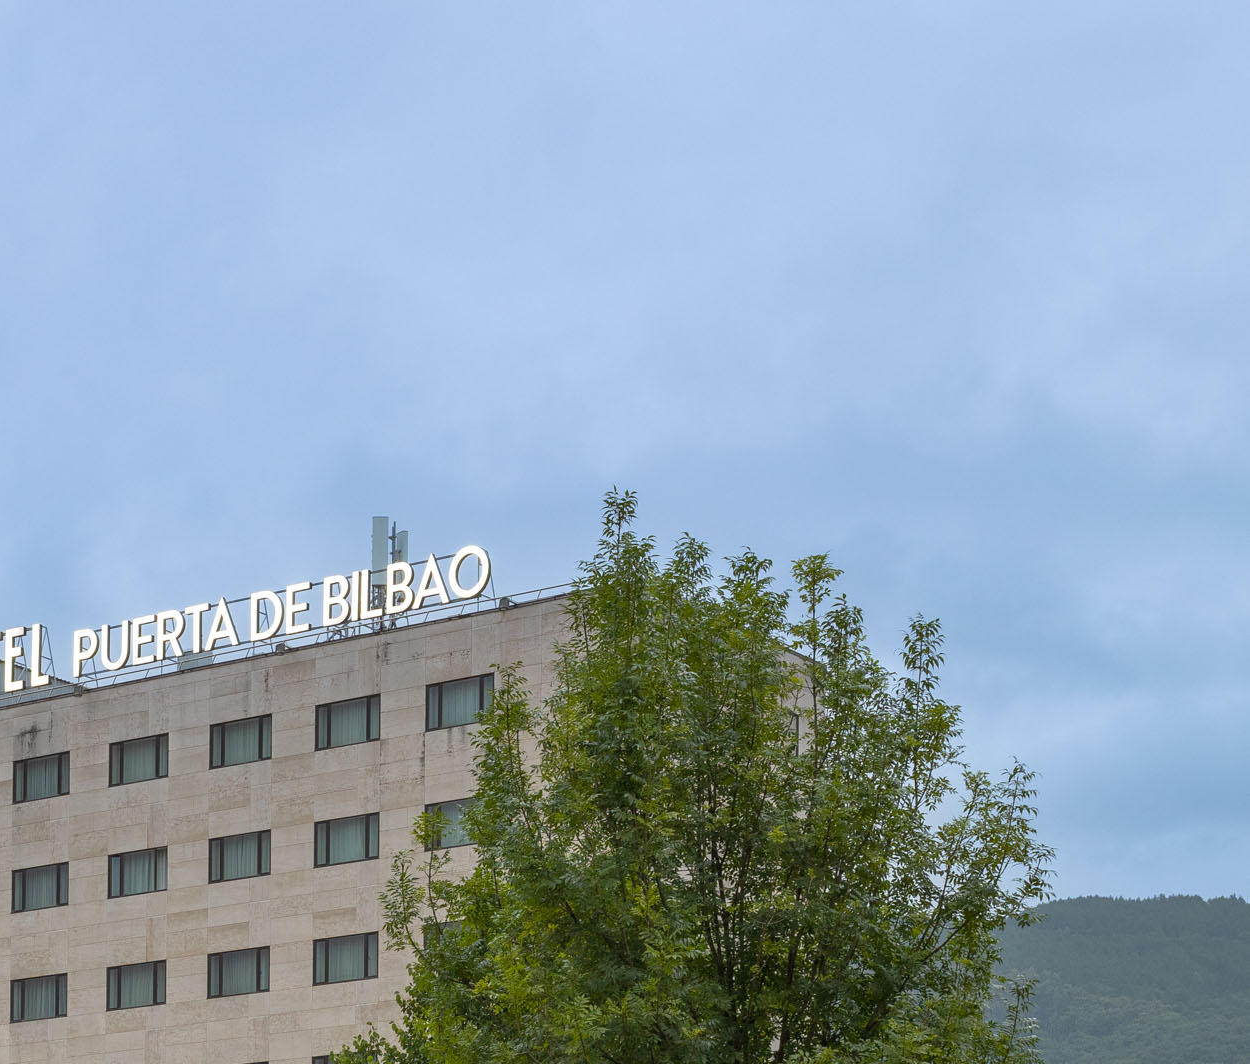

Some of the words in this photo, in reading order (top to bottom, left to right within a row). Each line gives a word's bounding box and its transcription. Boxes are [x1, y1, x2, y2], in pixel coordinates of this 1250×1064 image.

[72, 597, 238, 678] PUERTA
[250, 581, 310, 642] DE
[321, 544, 491, 627] BILBAO
